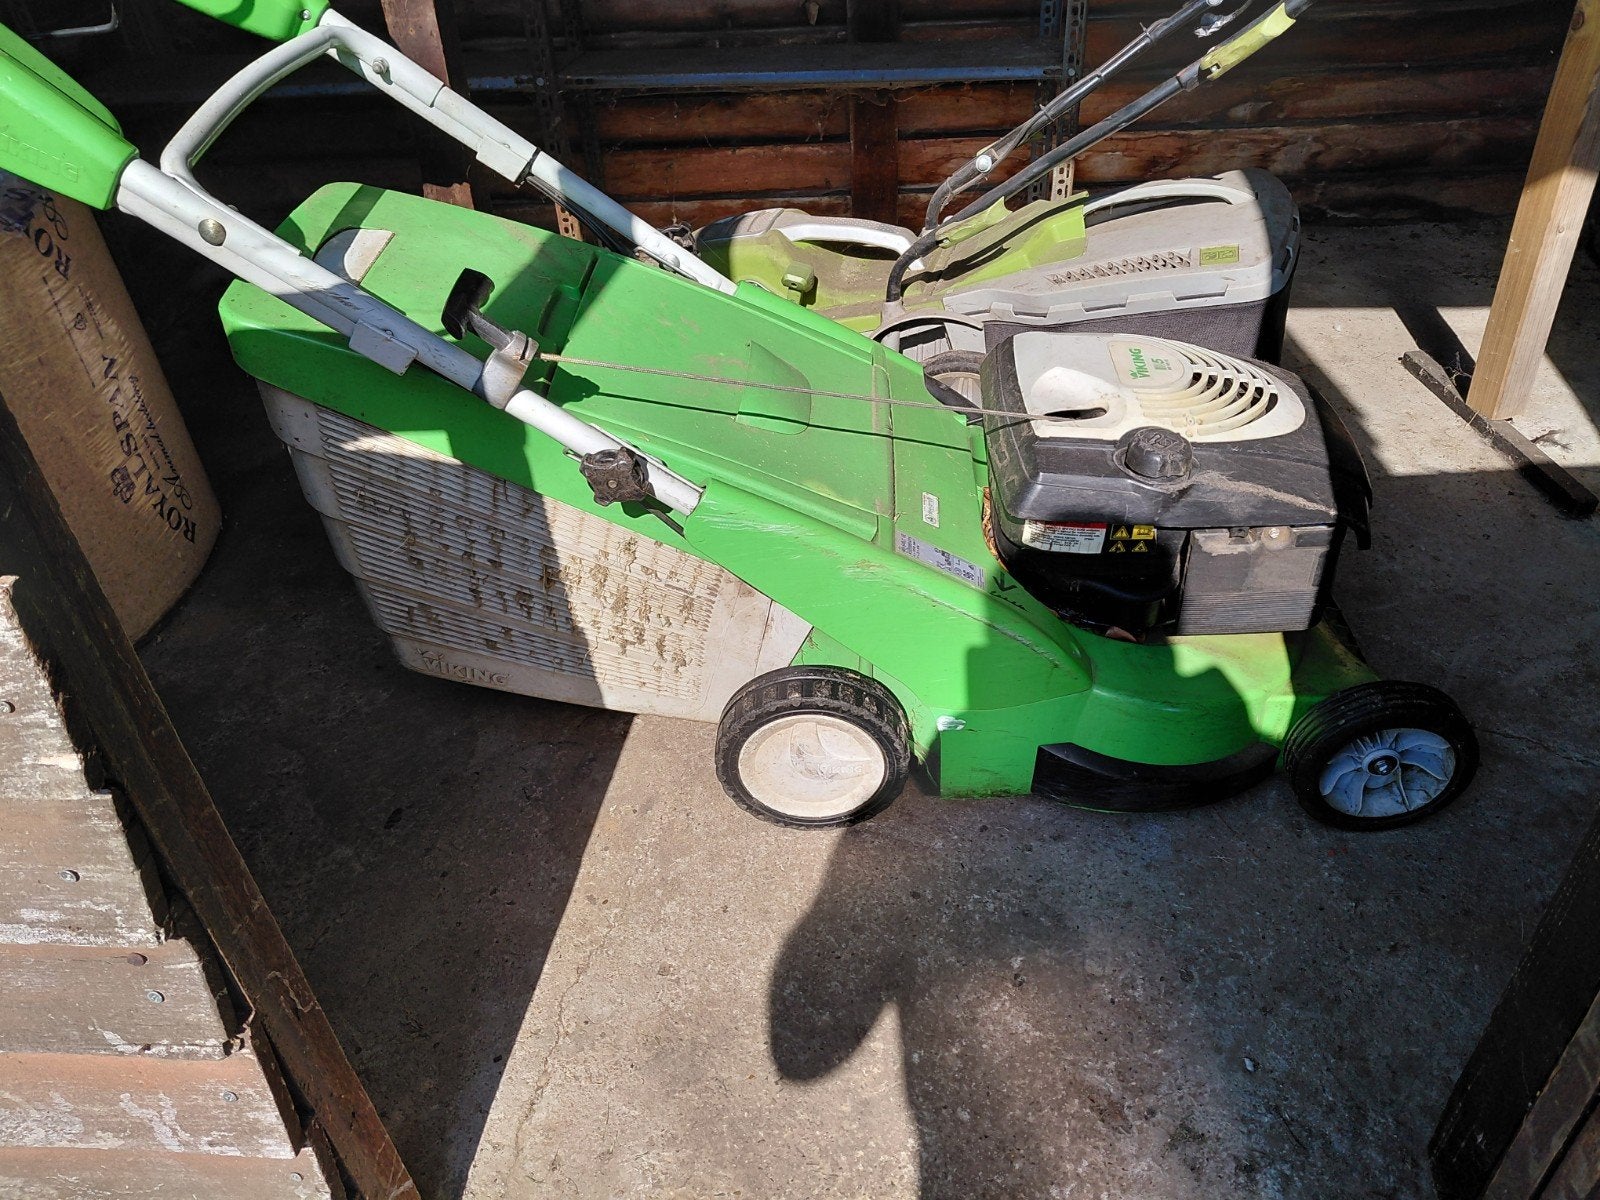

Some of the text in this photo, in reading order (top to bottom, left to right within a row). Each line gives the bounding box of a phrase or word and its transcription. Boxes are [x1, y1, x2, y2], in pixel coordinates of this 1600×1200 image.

[1129, 348, 1150, 378] VIKING
[102, 354, 197, 544] ROYALSPAN
[150, 433, 193, 510] Animal
[424, 657, 511, 685] VIKING
